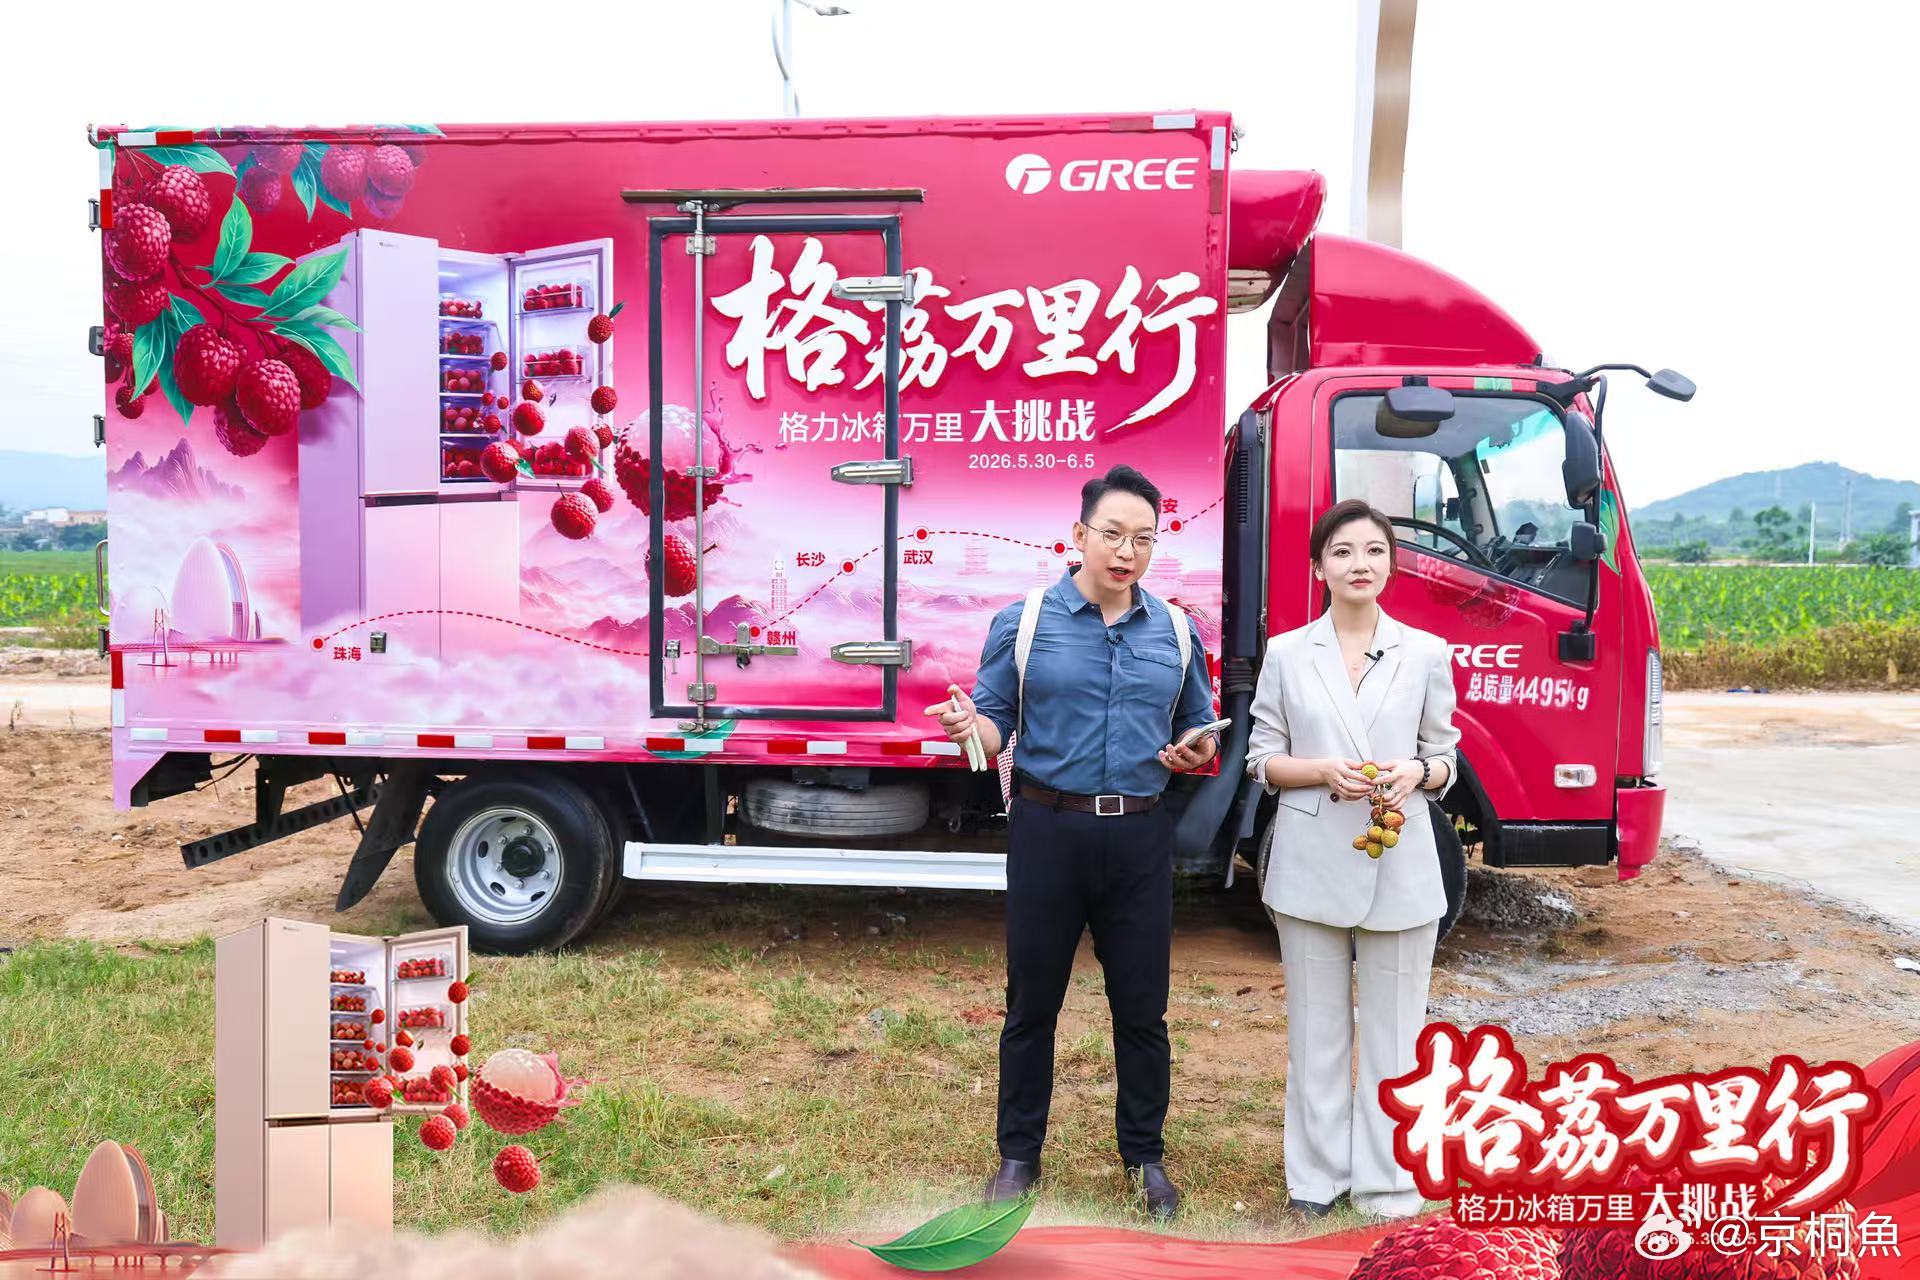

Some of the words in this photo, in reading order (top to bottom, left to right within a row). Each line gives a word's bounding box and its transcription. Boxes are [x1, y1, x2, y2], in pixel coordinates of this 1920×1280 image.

[1059, 157, 1200, 192] GREE
[711, 234, 1219, 433] 格荔万里行
[968, 453, 1095, 469] 2026.5.30-6.5
[1157, 498, 1178, 514] 安
[796, 552, 826, 567] 长沙
[903, 550, 934, 565] 武汉
[766, 630, 796, 646] 赣州
[333, 646, 362, 661] 珠海
[1447, 643, 1523, 668] REE
